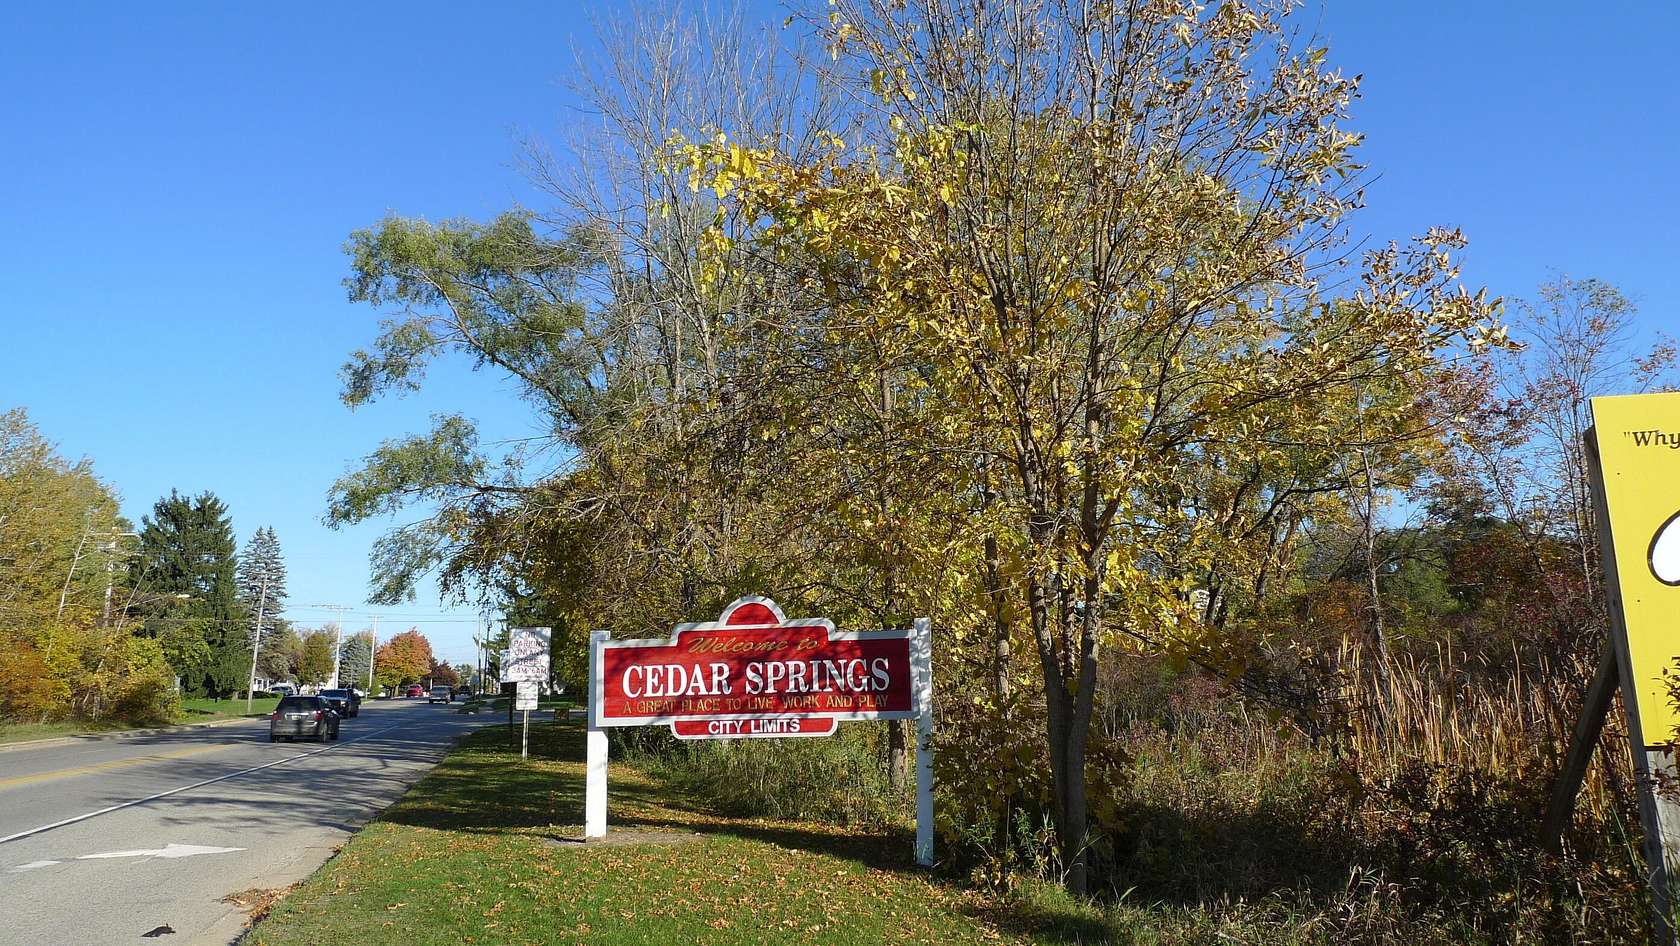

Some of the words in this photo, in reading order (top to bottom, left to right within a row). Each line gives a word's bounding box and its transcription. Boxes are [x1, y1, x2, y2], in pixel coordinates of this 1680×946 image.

[688, 637, 788, 653] Welcome
[798, 636, 818, 650] to
[514, 657, 543, 665] STREET
[622, 662, 732, 698] CEDAR
[745, 657, 890, 695] SPRINGS
[623, 702, 632, 714] A
[637, 700, 675, 714] GREAT
[681, 698, 720, 712] PLACE
[727, 698, 741, 711] TO
[748, 697, 774, 710] LIVE
[783, 695, 820, 709] WORK
[826, 695, 853, 708] AND
[858, 694, 889, 708] PLAY
[708, 720, 744, 734] CITY
[751, 718, 800, 733] LIMITS
